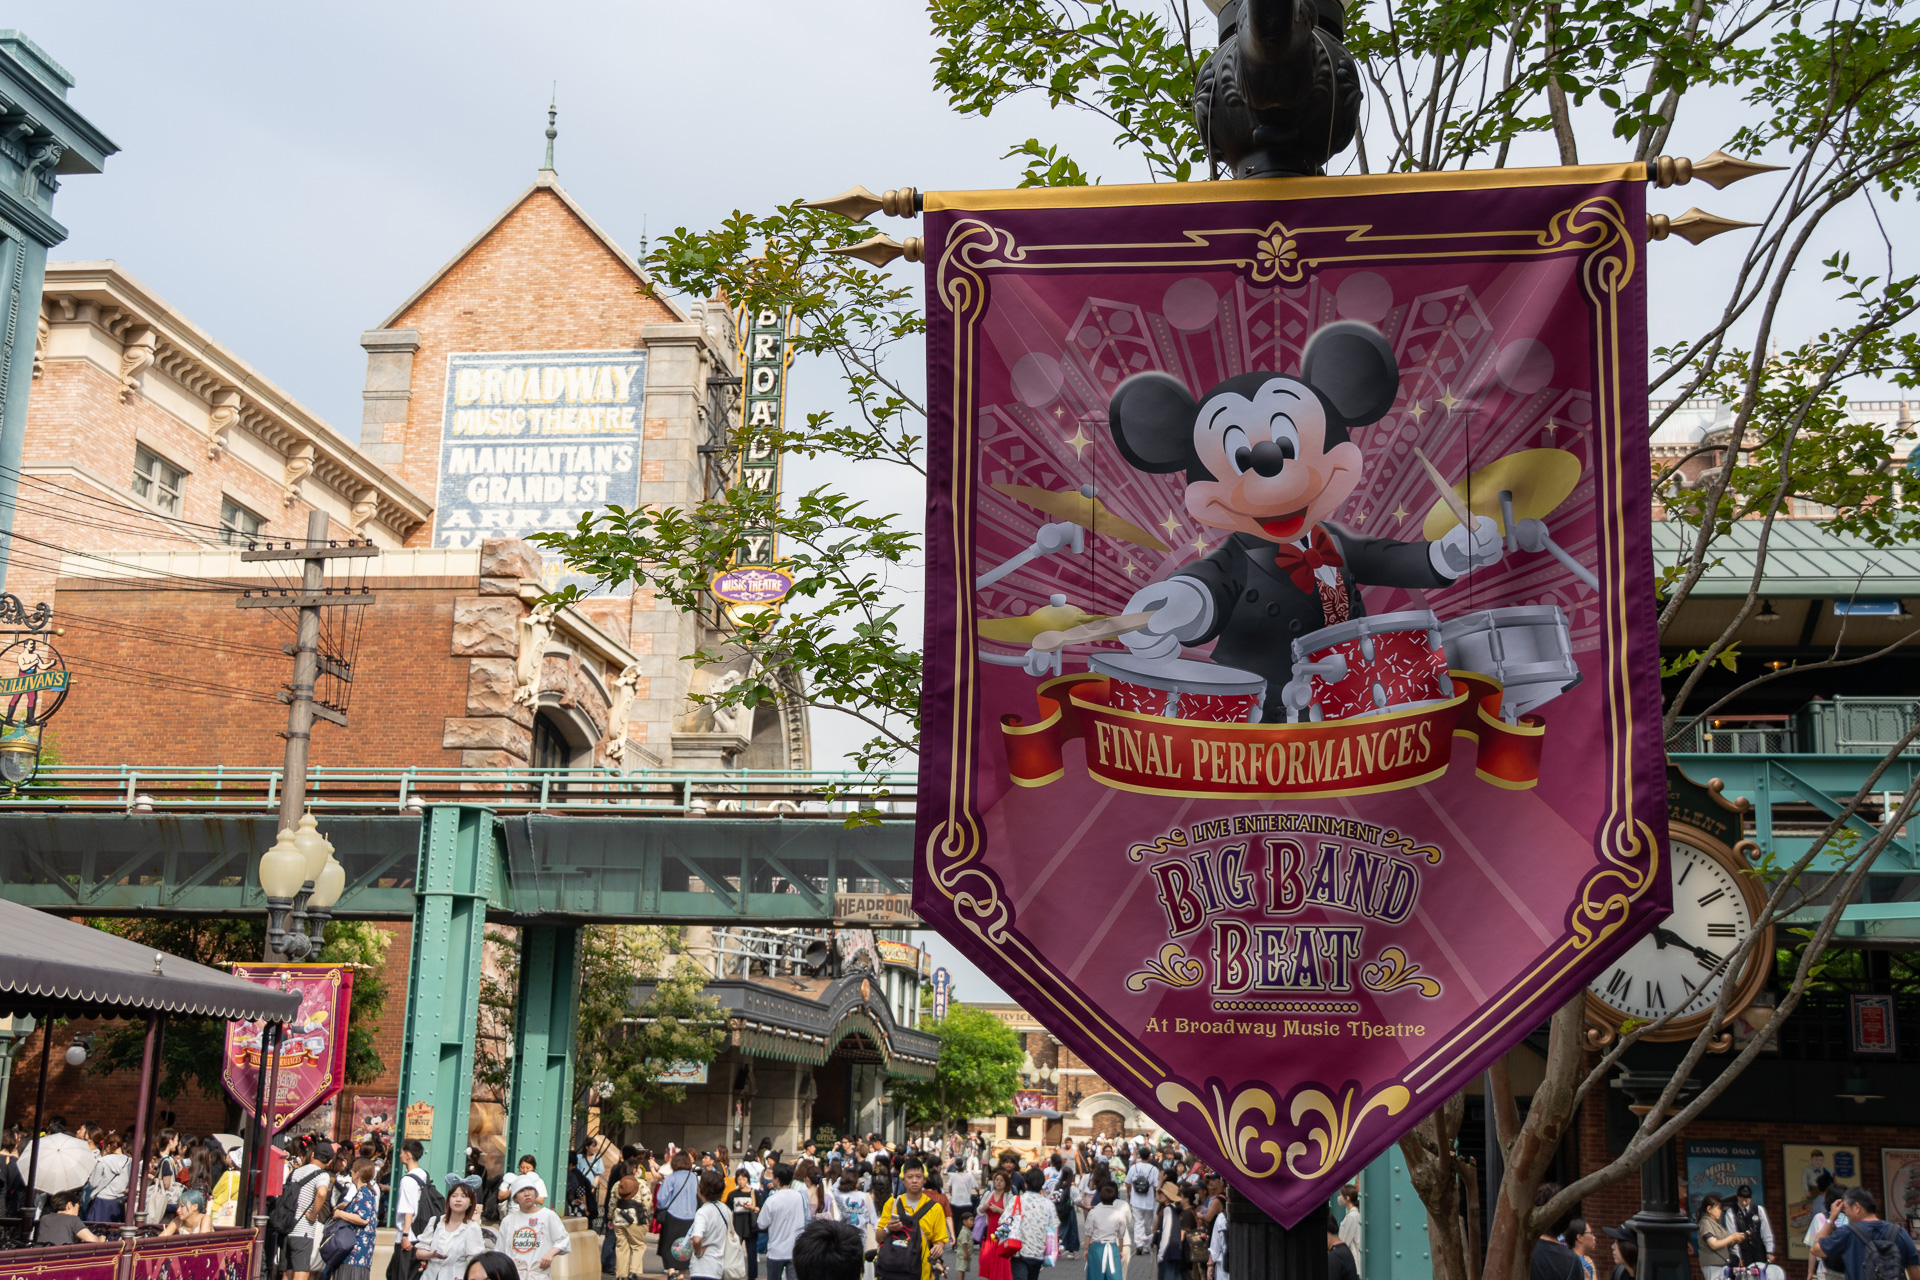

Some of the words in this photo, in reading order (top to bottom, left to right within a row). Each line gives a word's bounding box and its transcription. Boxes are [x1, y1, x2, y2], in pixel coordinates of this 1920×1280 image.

[454, 364, 639, 406] BROADWAY
[453, 408, 527, 436] MUSIC
[527, 406, 636, 435] THEATRE
[448, 445, 635, 474] MANHATTAN'S
[466, 475, 611, 504] GRANDEST
[721, 579, 747, 592] MUSIC
[748, 578, 782, 592] THEATRE
[1095, 720, 1182, 779] FINAL
[1191, 720, 1432, 786] PERFORMANCES
[1193, 818, 1229, 843] LIVE
[1234, 813, 1382, 844] ENTERTAINMENT
[1668, 805, 1727, 835] ALENT
[1151, 843, 1256, 938] BIG
[1264, 838, 1419, 924] BAND
[1211, 919, 1363, 996] BEAT
[993, 1013, 1034, 1021] ERVICE
[1145, 1017, 1168, 1034] At
[1174, 1017, 1277, 1037] Broadway
[1283, 1019, 1340, 1037] Music
[1346, 1020, 1426, 1037] Theatre
[264, 1087, 288, 1099] BAT
[1690, 1146, 1728, 1154] LEAVING
[1732, 1147, 1757, 1155] DAILY
[1705, 1161, 1737, 1177] MOLLY
[1716, 1172, 1758, 1187] BROWN
